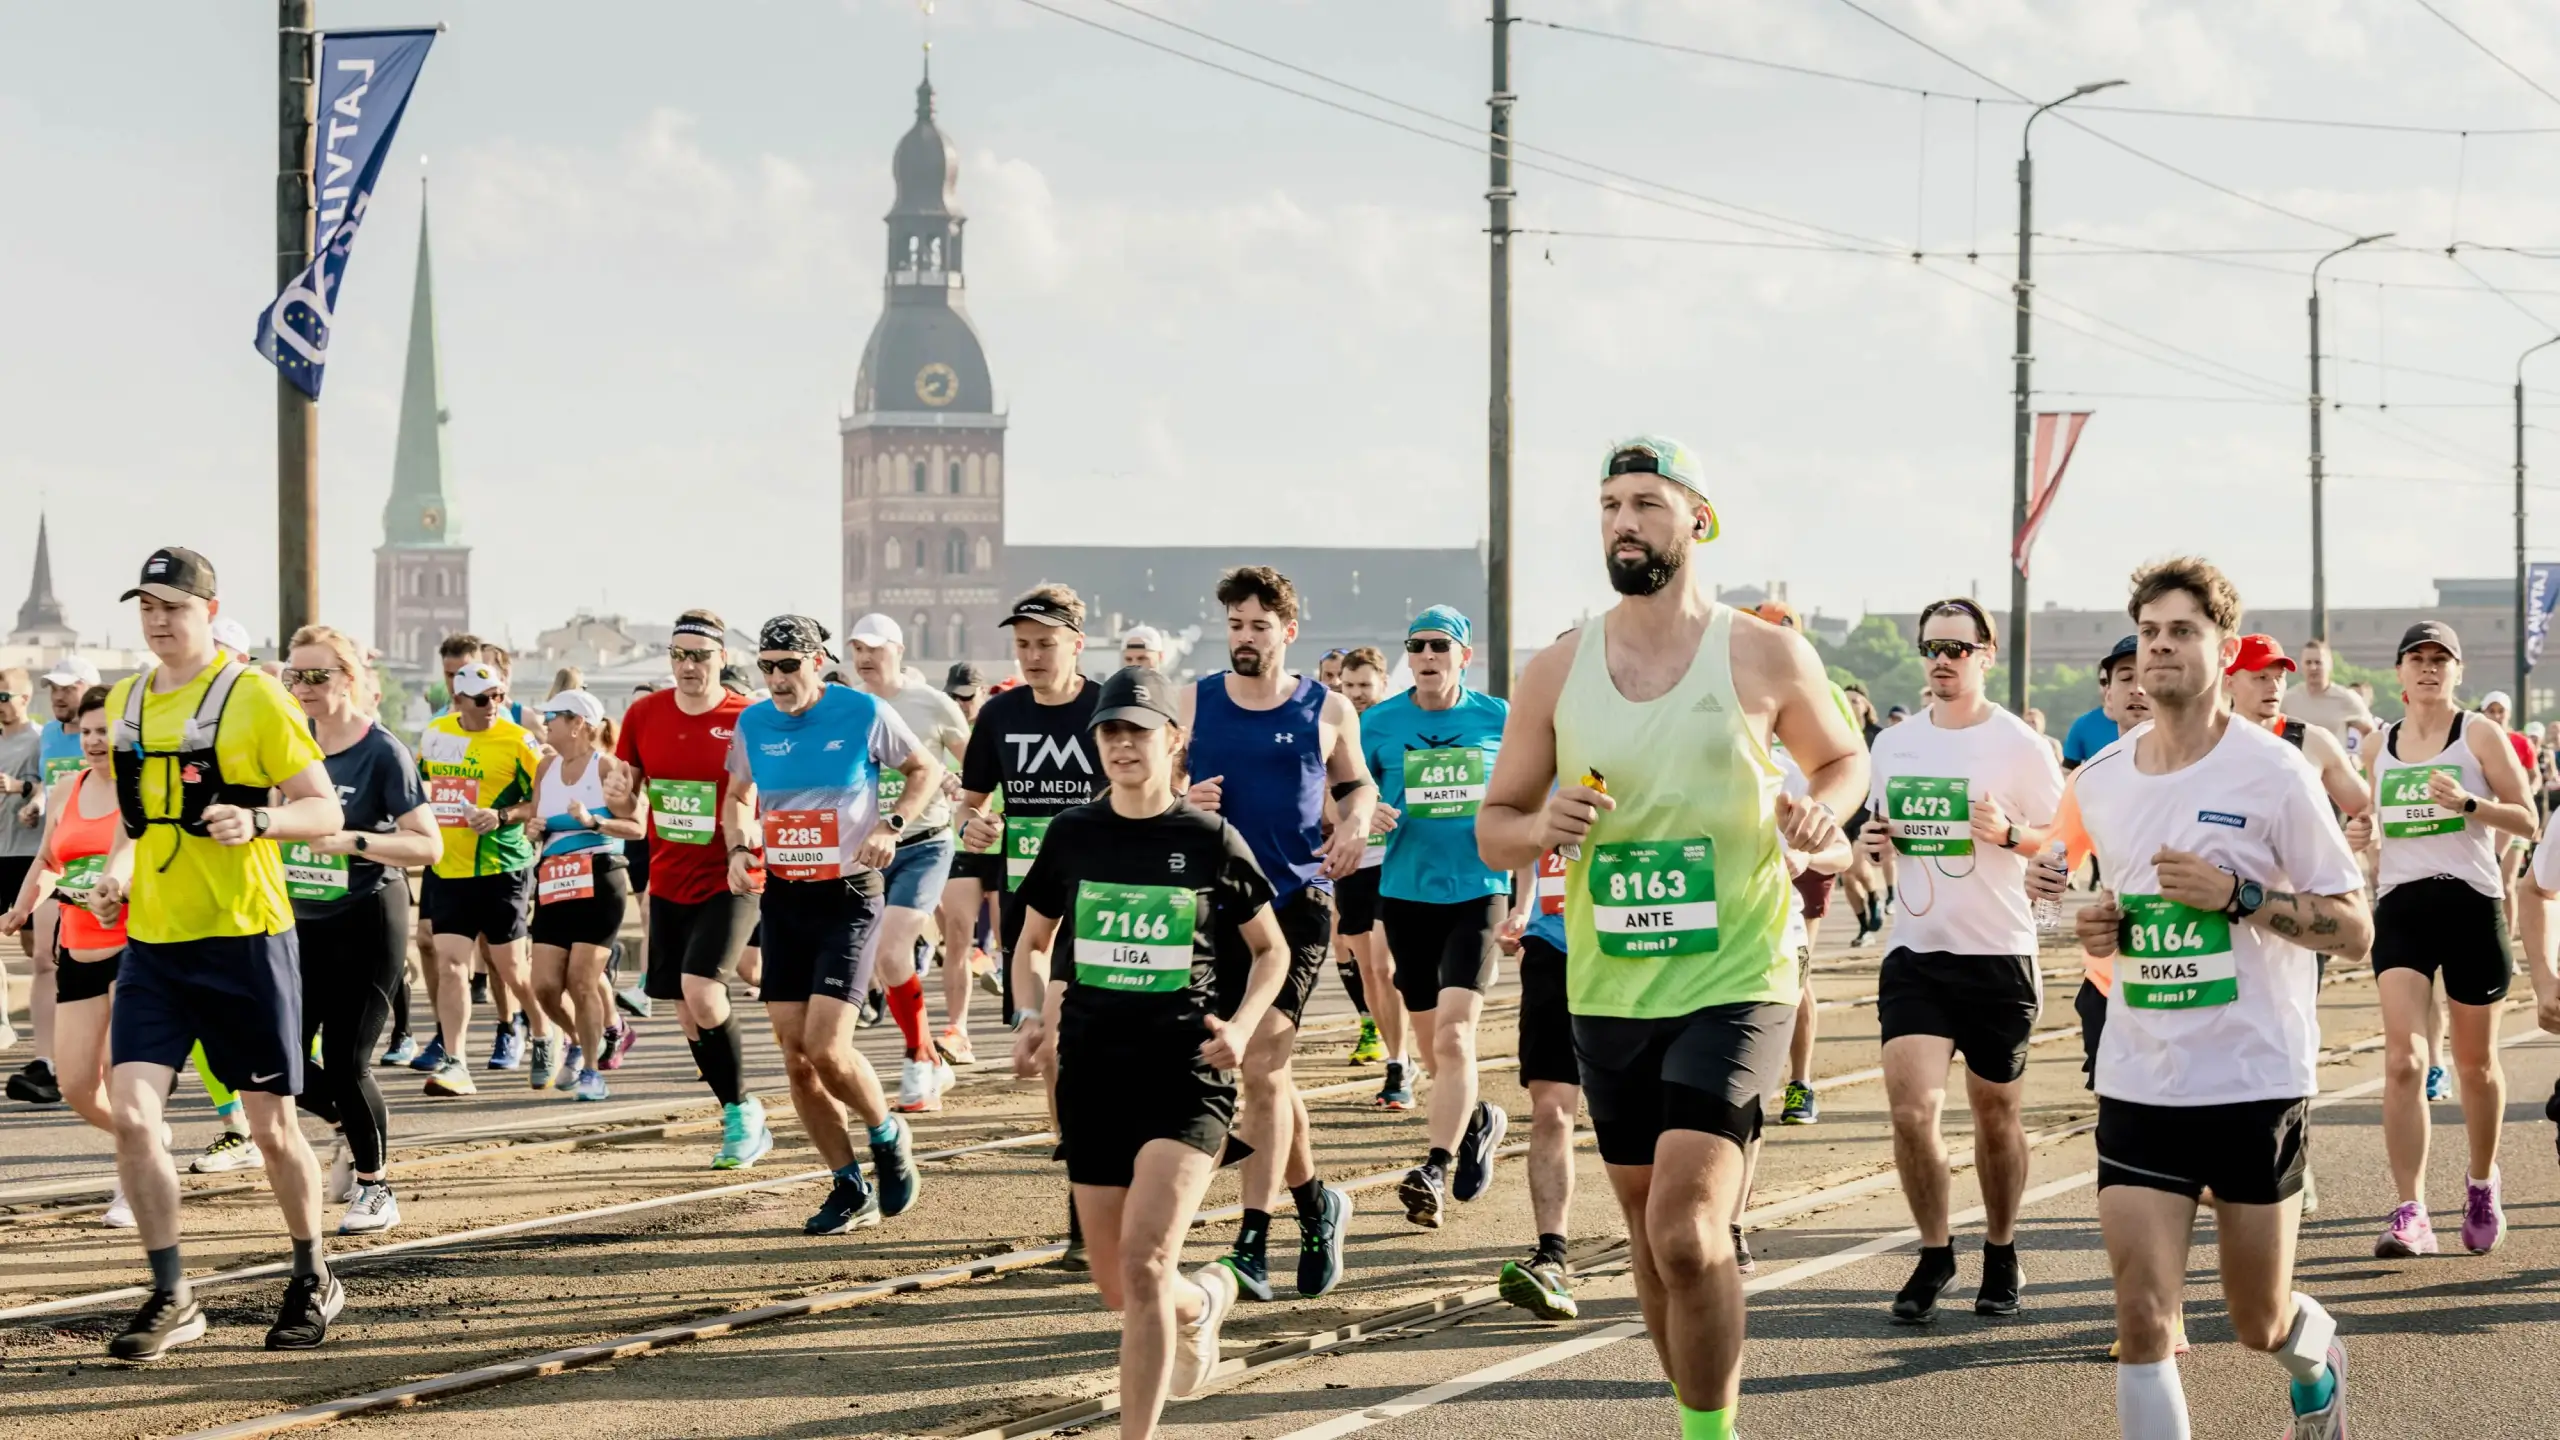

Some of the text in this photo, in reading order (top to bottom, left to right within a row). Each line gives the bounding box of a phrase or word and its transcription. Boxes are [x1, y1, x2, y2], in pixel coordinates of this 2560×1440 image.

[1005, 733, 1094, 775] TM
[432, 764, 484, 780] AUSTRALIA
[1420, 765, 1469, 783] 4816
[1006, 779, 1092, 793] TOP MEDIA
[1424, 789, 1467, 801] MARTIN
[661, 795, 702, 813] 5062
[1901, 796, 1952, 817] 6473
[2406, 807, 2435, 819] EGLE
[777, 827, 823, 846] 2285
[778, 852, 824, 862] CLAUDIO
[549, 861, 581, 879] 1199
[1609, 870, 1687, 901] 8163
[1096, 910, 1170, 940] 7166
[1625, 911, 1674, 928] ANTE
[2130, 921, 2205, 953] 8164
[1113, 945, 1151, 965] LĪGA
[2141, 963, 2199, 980] ROKAS
